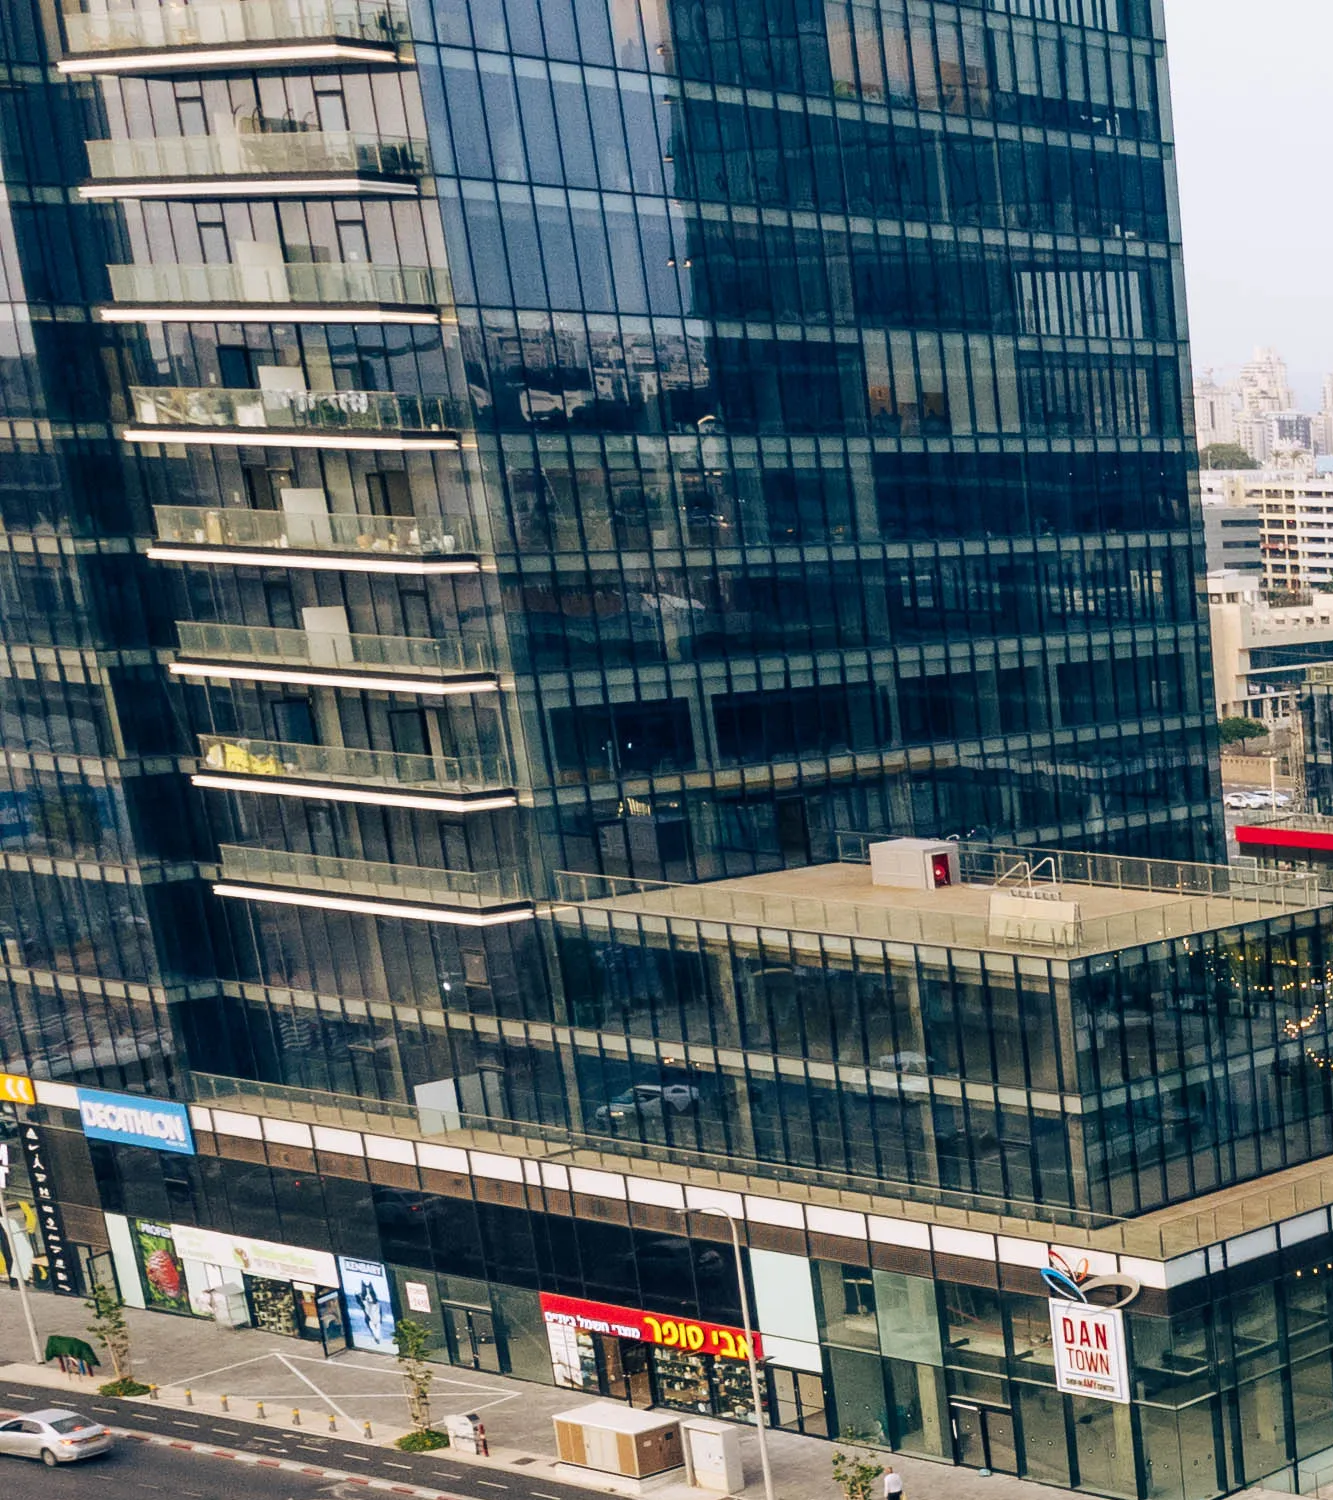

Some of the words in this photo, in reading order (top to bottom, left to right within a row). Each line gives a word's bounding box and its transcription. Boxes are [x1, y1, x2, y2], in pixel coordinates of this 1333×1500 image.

[82, 1101, 186, 1143] DECATHLON
[643, 1316, 705, 1350] סופר
[711, 1330, 755, 1360] אבי
[1062, 1316, 1108, 1351] DAN
[1066, 1346, 1110, 1376] TOWN
